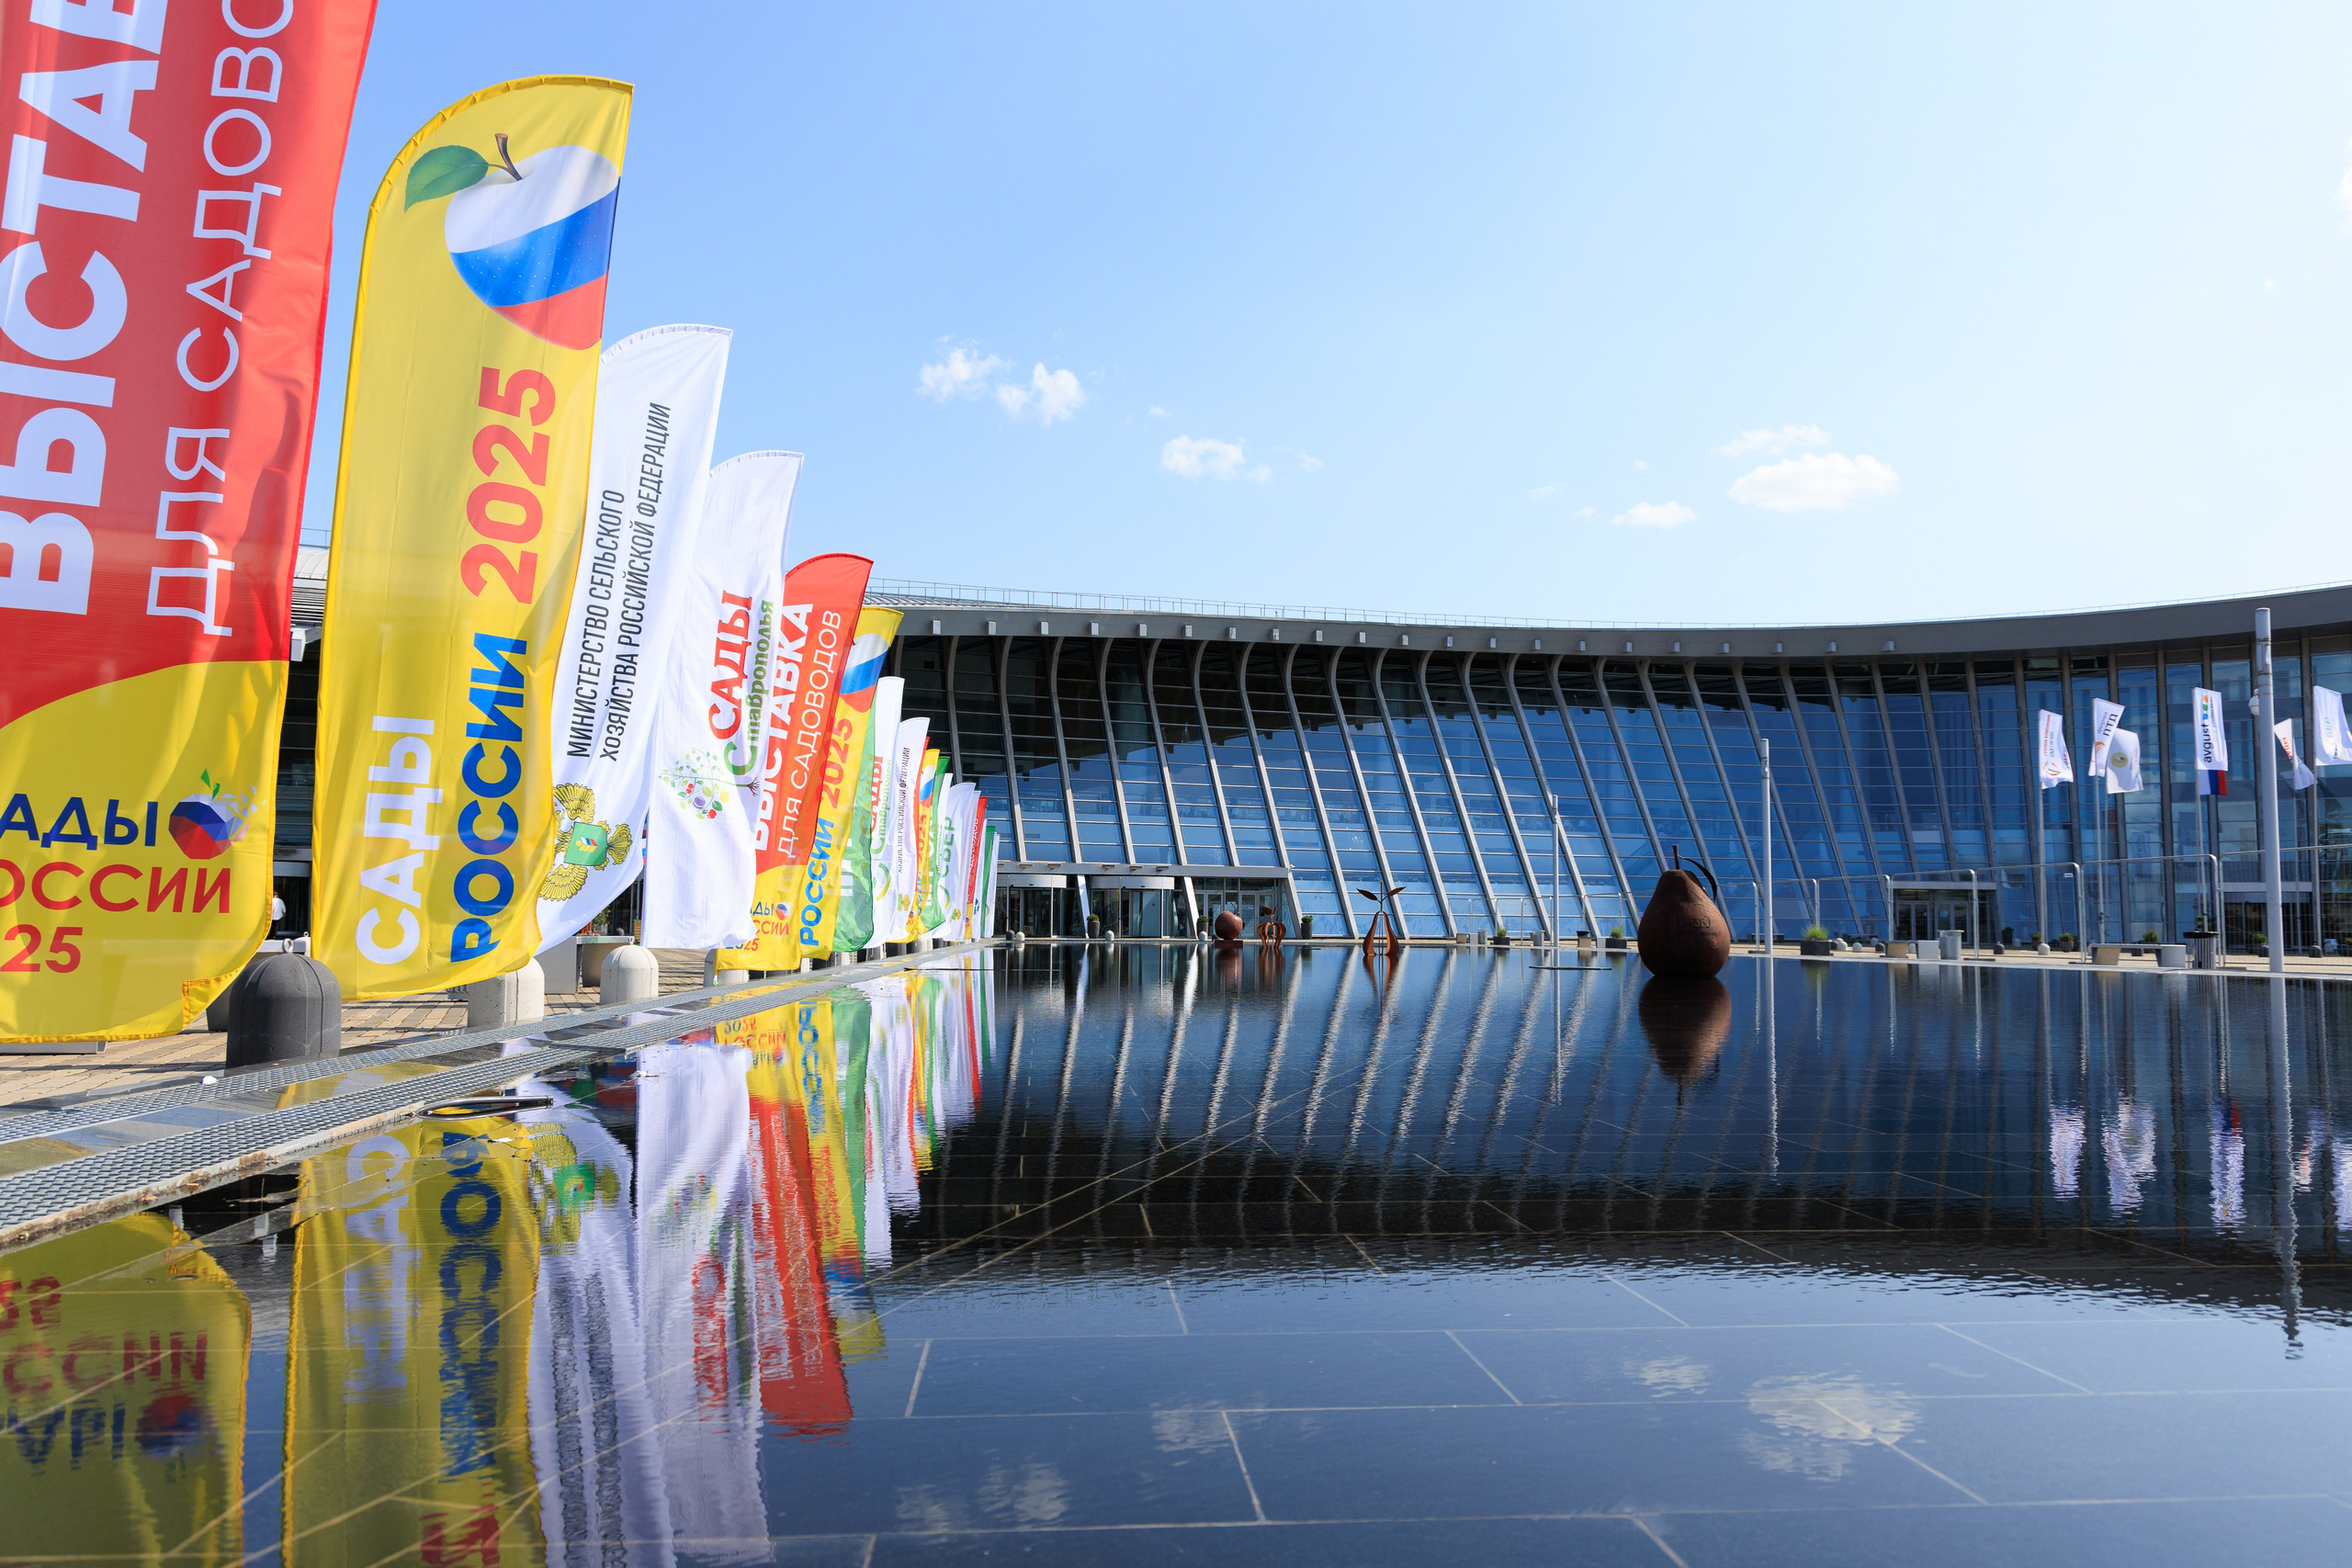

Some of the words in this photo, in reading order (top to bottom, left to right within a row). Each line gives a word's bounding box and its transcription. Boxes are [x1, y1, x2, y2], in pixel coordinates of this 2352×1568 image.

[459, 366, 555, 604] 2025
[637, 401, 672, 517] ФЕДЕРАЦИИ
[146, 426, 235, 637] ДЛЯ
[618, 521, 656, 647] РОССИЙСКОЙ
[567, 603, 609, 758] МИНИСТЕРСТВО
[589, 490, 625, 601] СЕЛЬСКОГО
[708, 590, 752, 739] САДЫ
[723, 600, 774, 776] Ставрополья
[599, 652, 639, 762] ХОЗЯЙСТВА
[778, 797, 802, 858] ДЛЯ
[791, 610, 842, 789] САДОВОДОВ
[815, 716, 853, 809] 2025
[2200, 723, 2213, 763] avgust
[356, 716, 443, 964] САДЫ
[449, 633, 527, 963] РОССИИ
[0, 924, 84, 974] 25
[750, 901, 775, 917] ДЫ
[799, 817, 834, 946] РОССИИ
